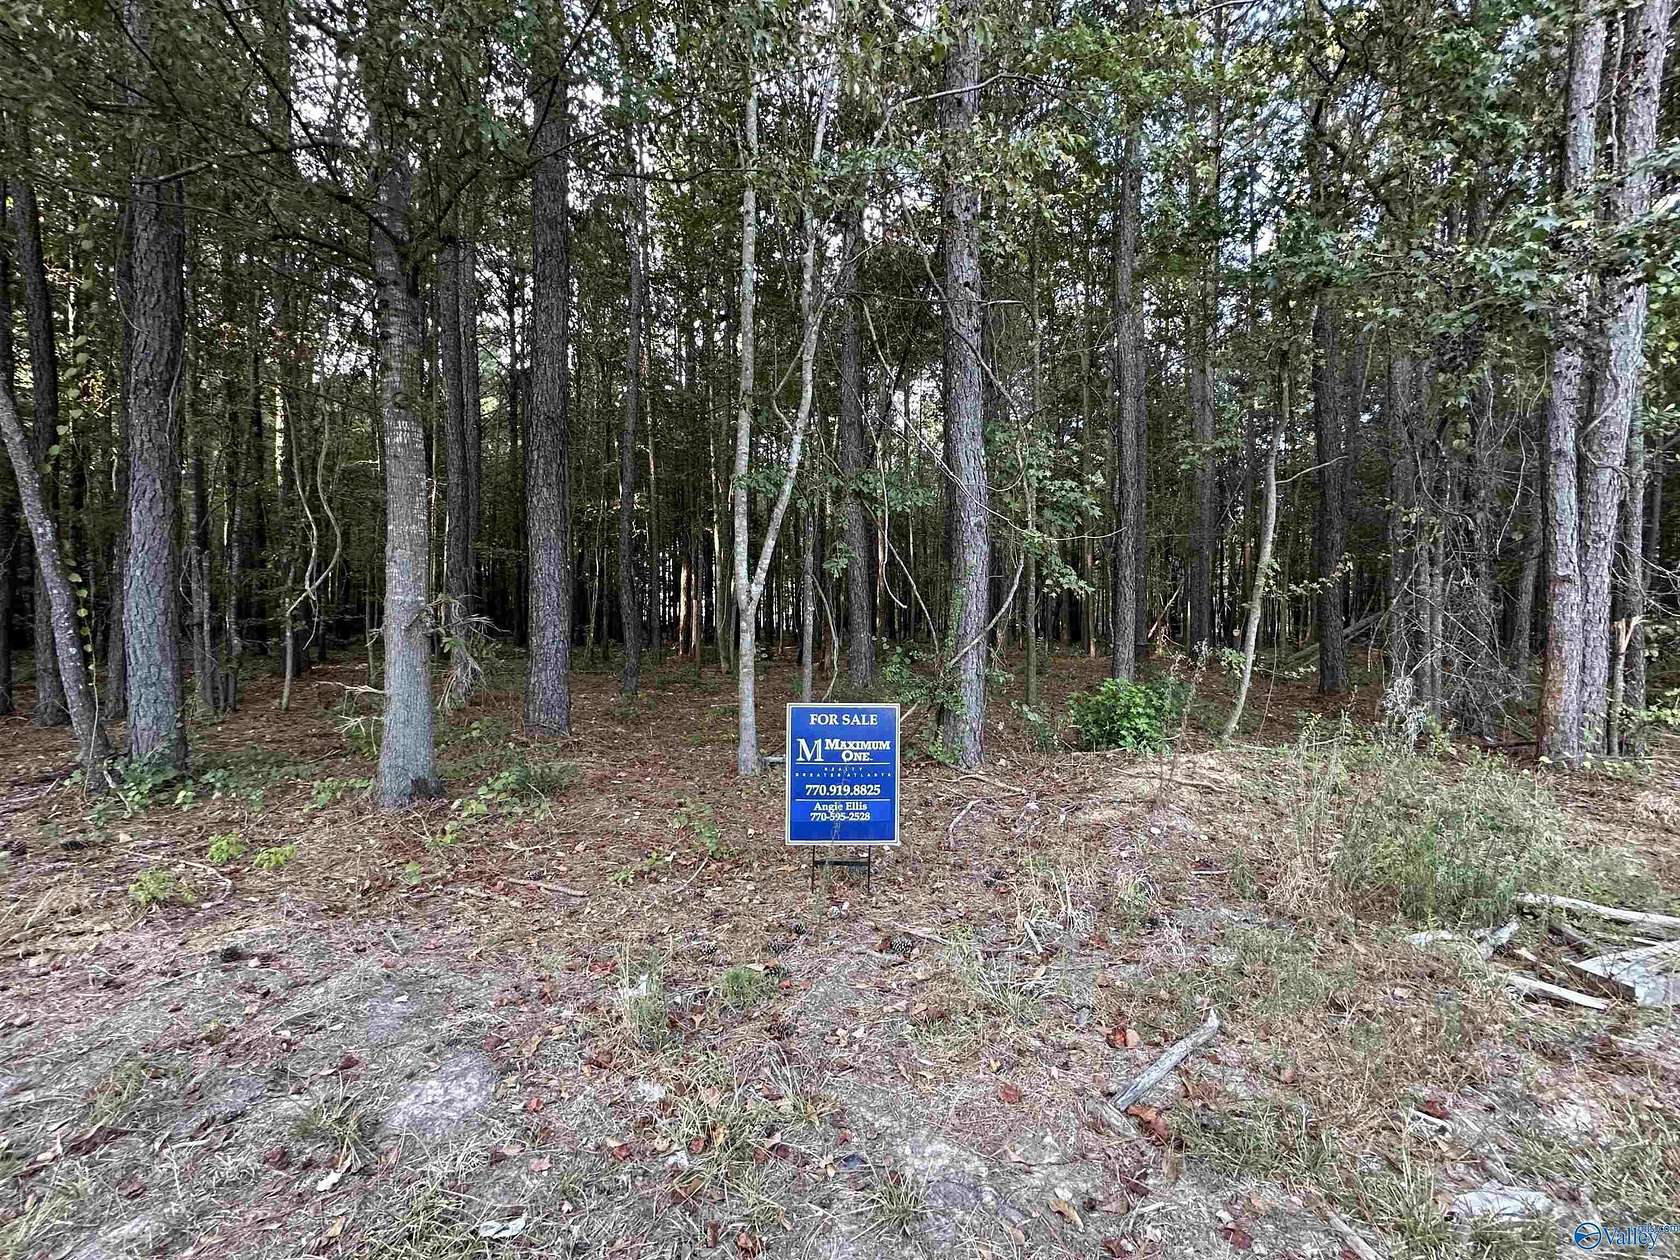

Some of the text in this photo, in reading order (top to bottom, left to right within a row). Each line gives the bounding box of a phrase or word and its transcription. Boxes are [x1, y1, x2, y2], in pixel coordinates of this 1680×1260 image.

[809, 713, 878, 726] FOR SALE
[796, 738, 824, 762] M
[824, 738, 891, 750] MAXIMUM
[805, 784, 881, 796] 770.919.8825
[813, 801, 868, 813] Angie Ellis
[810, 812, 871, 821] 770-595-2528
